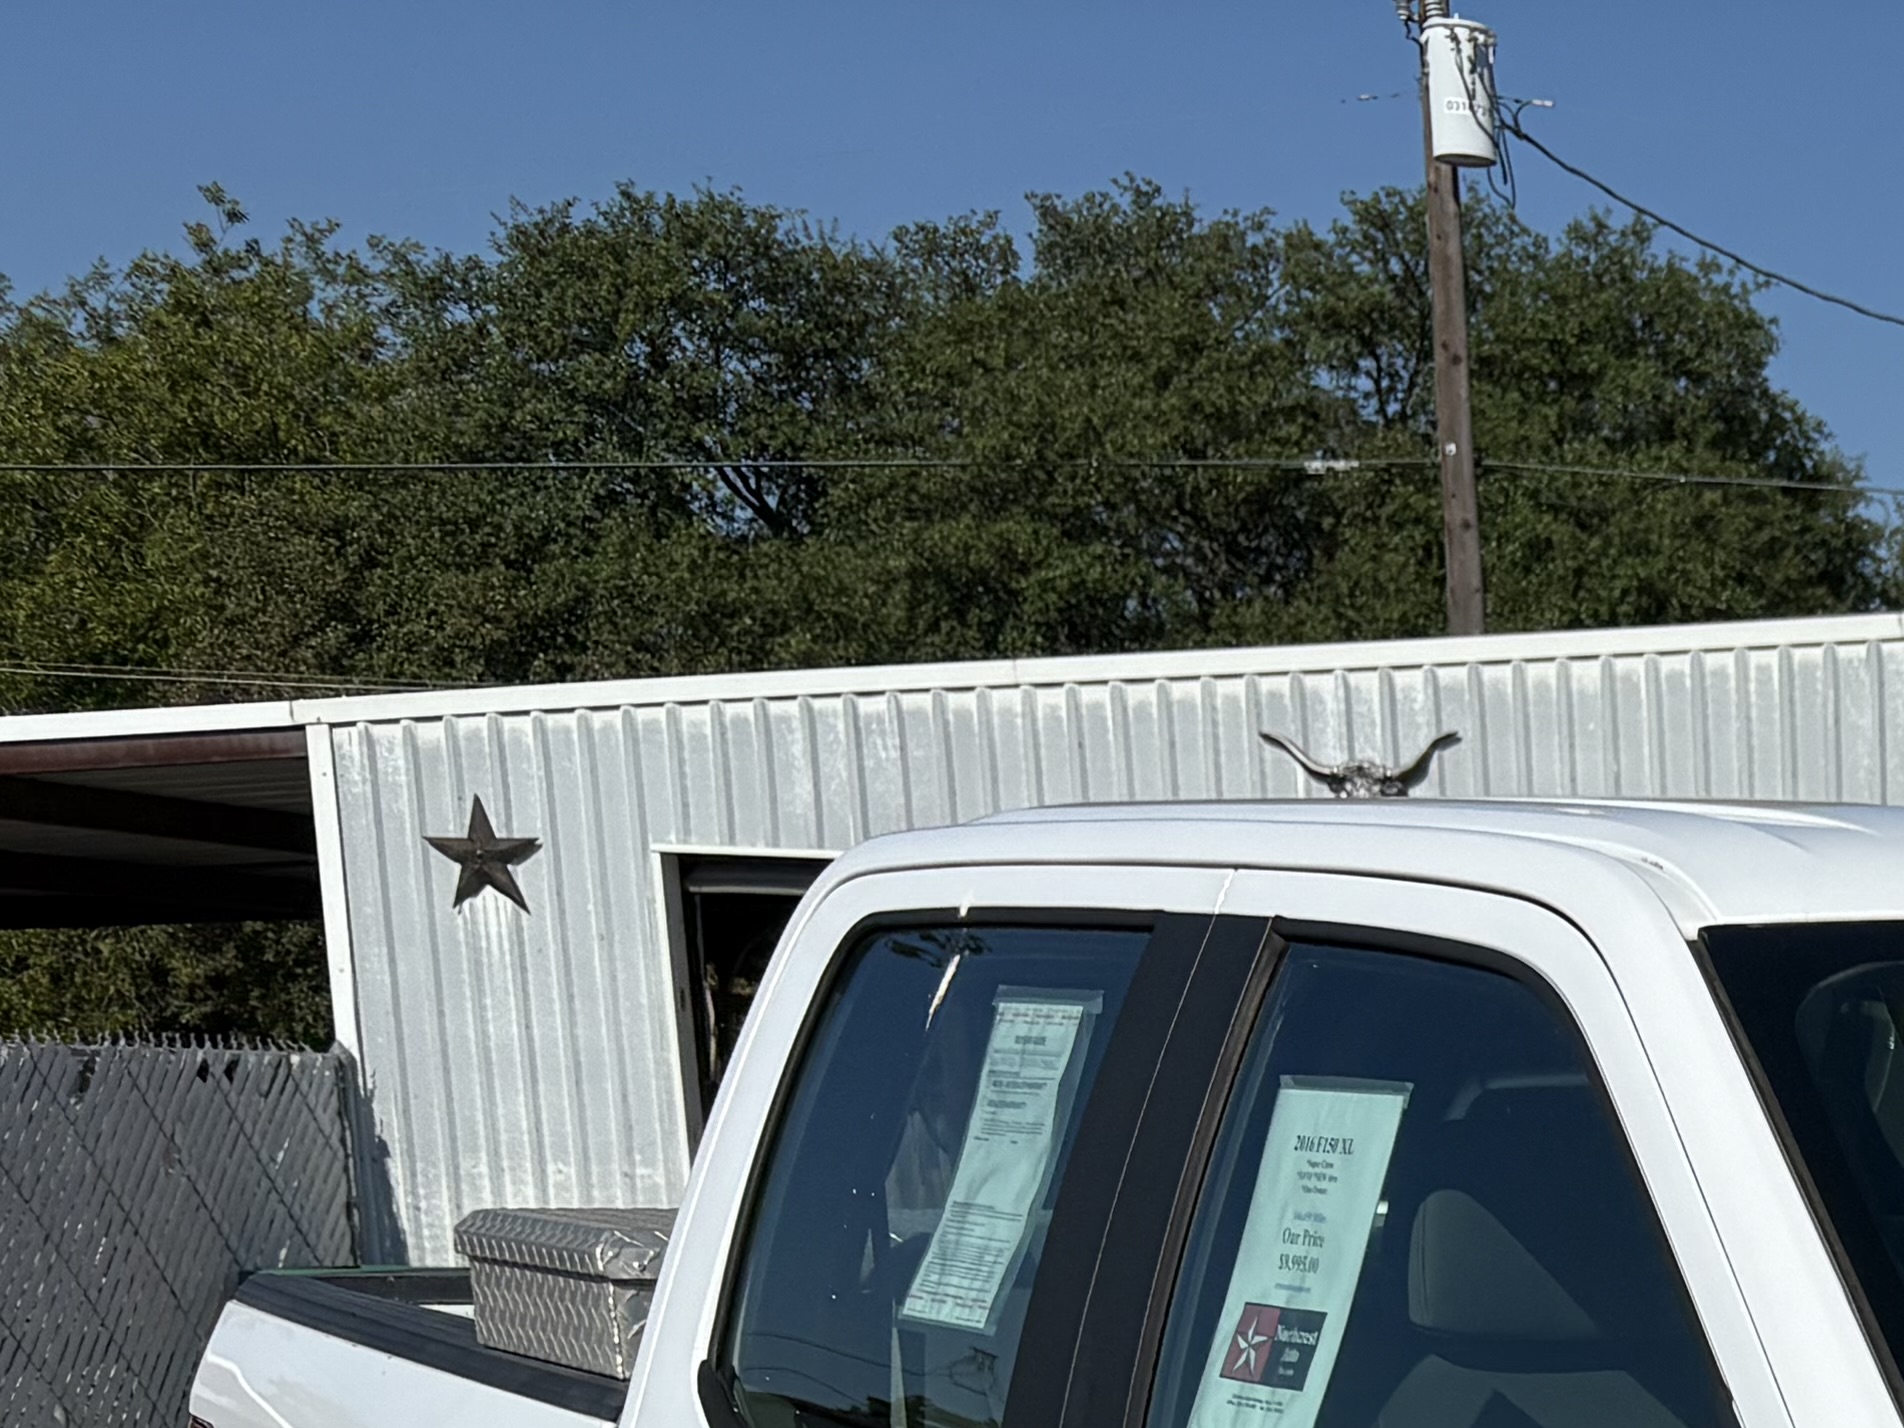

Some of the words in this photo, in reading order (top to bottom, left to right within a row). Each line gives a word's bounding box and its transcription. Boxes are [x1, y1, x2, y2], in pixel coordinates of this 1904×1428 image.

[1294, 1134, 1316, 1152] 2016
[1282, 1226, 1301, 1245] Our
[1302, 1229, 1325, 1248] Price
[1274, 1324, 1318, 1346] Northcrest
